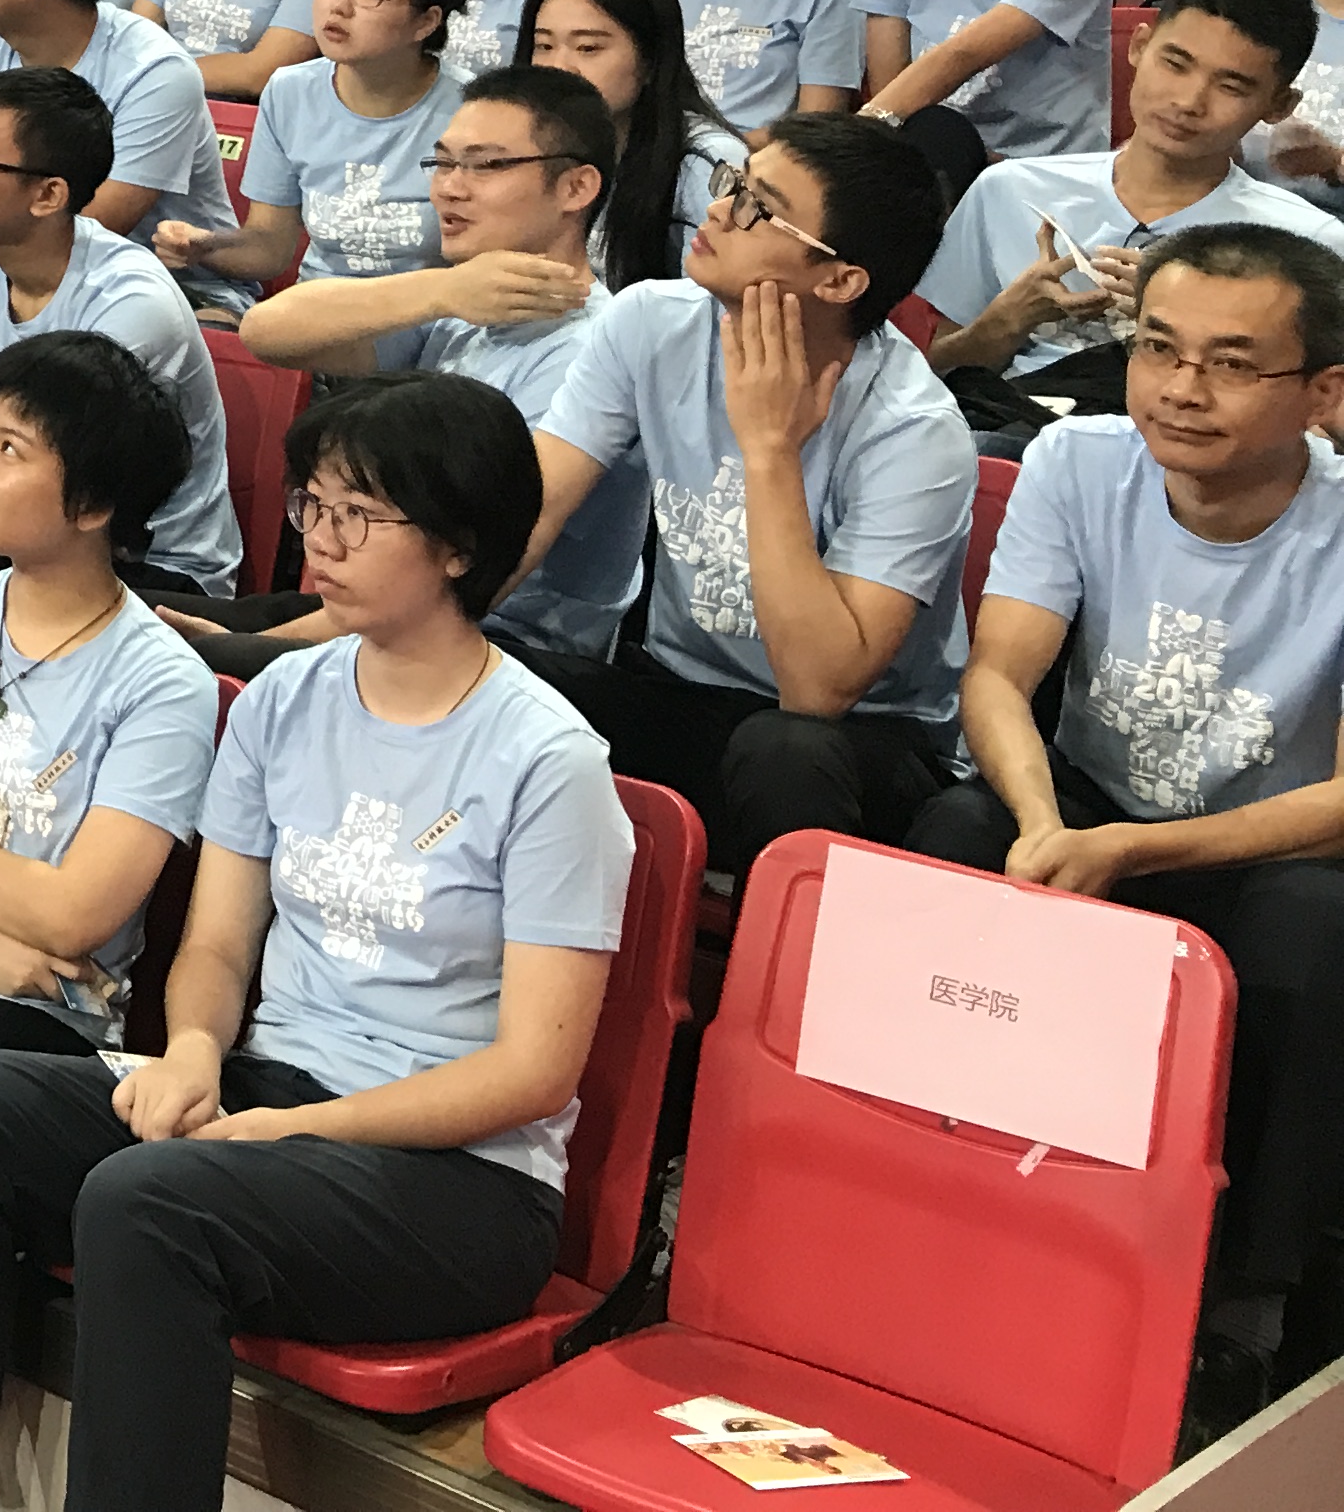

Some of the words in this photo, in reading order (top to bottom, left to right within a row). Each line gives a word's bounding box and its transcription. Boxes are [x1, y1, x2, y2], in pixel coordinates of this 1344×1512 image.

[218, 138, 239, 154] 17
[336, 201, 360, 218] 20
[354, 216, 378, 232] 17
[1133, 670, 1181, 707] 20
[1169, 704, 1211, 730] 17
[317, 846, 358, 876] 20
[339, 876, 370, 901] 17
[929, 974, 1020, 1023] 医学院
